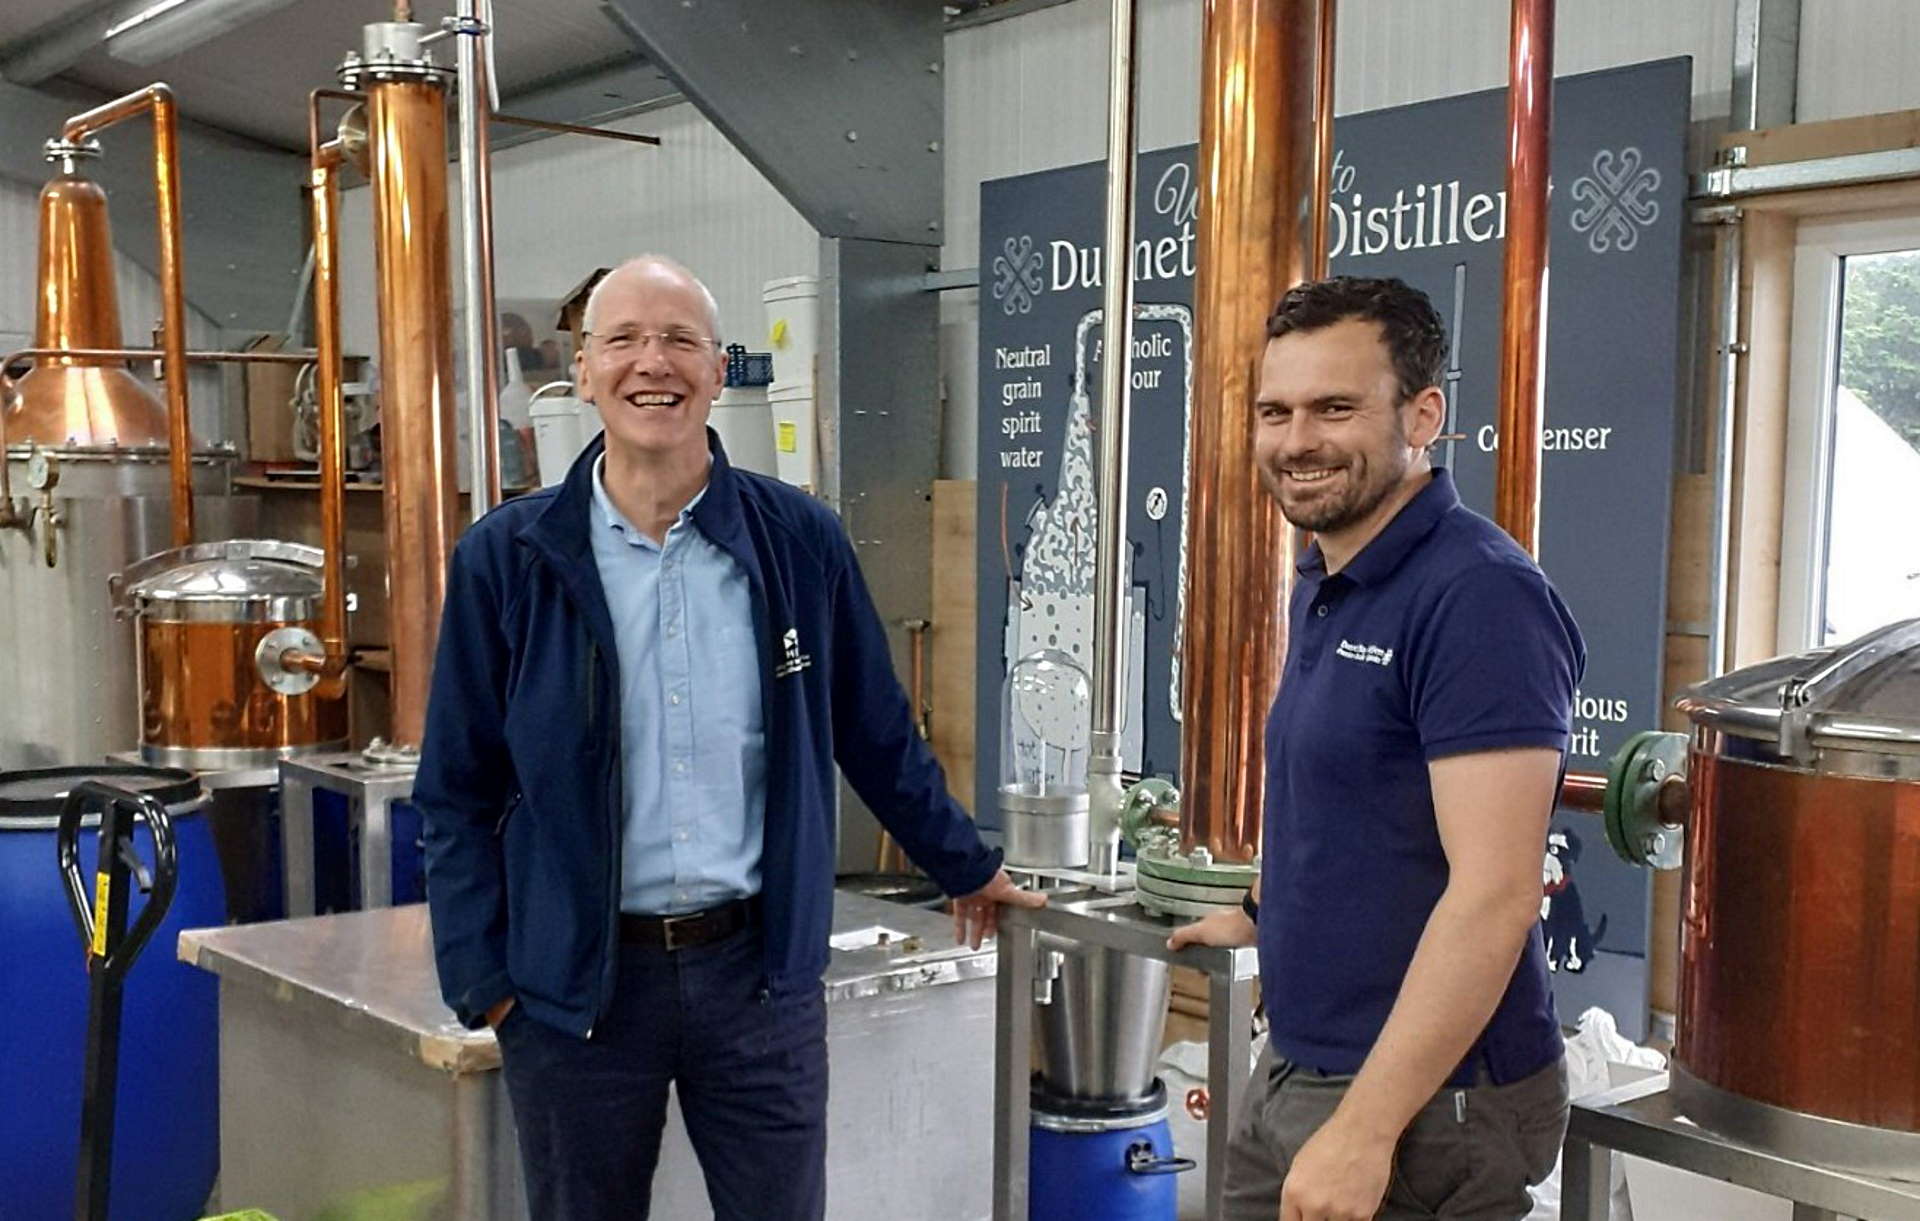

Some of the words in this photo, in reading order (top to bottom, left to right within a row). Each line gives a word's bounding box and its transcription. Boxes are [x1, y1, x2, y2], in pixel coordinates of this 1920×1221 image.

[1050, 221, 1197, 291] Dunet
[1329, 180, 1554, 259] Distiller
[996, 344, 1051, 369] Neutral
[1002, 376, 1042, 406] grain
[1002, 411, 1042, 440] spirit
[1477, 424, 1612, 452] Censer
[1000, 447, 1044, 468] water
